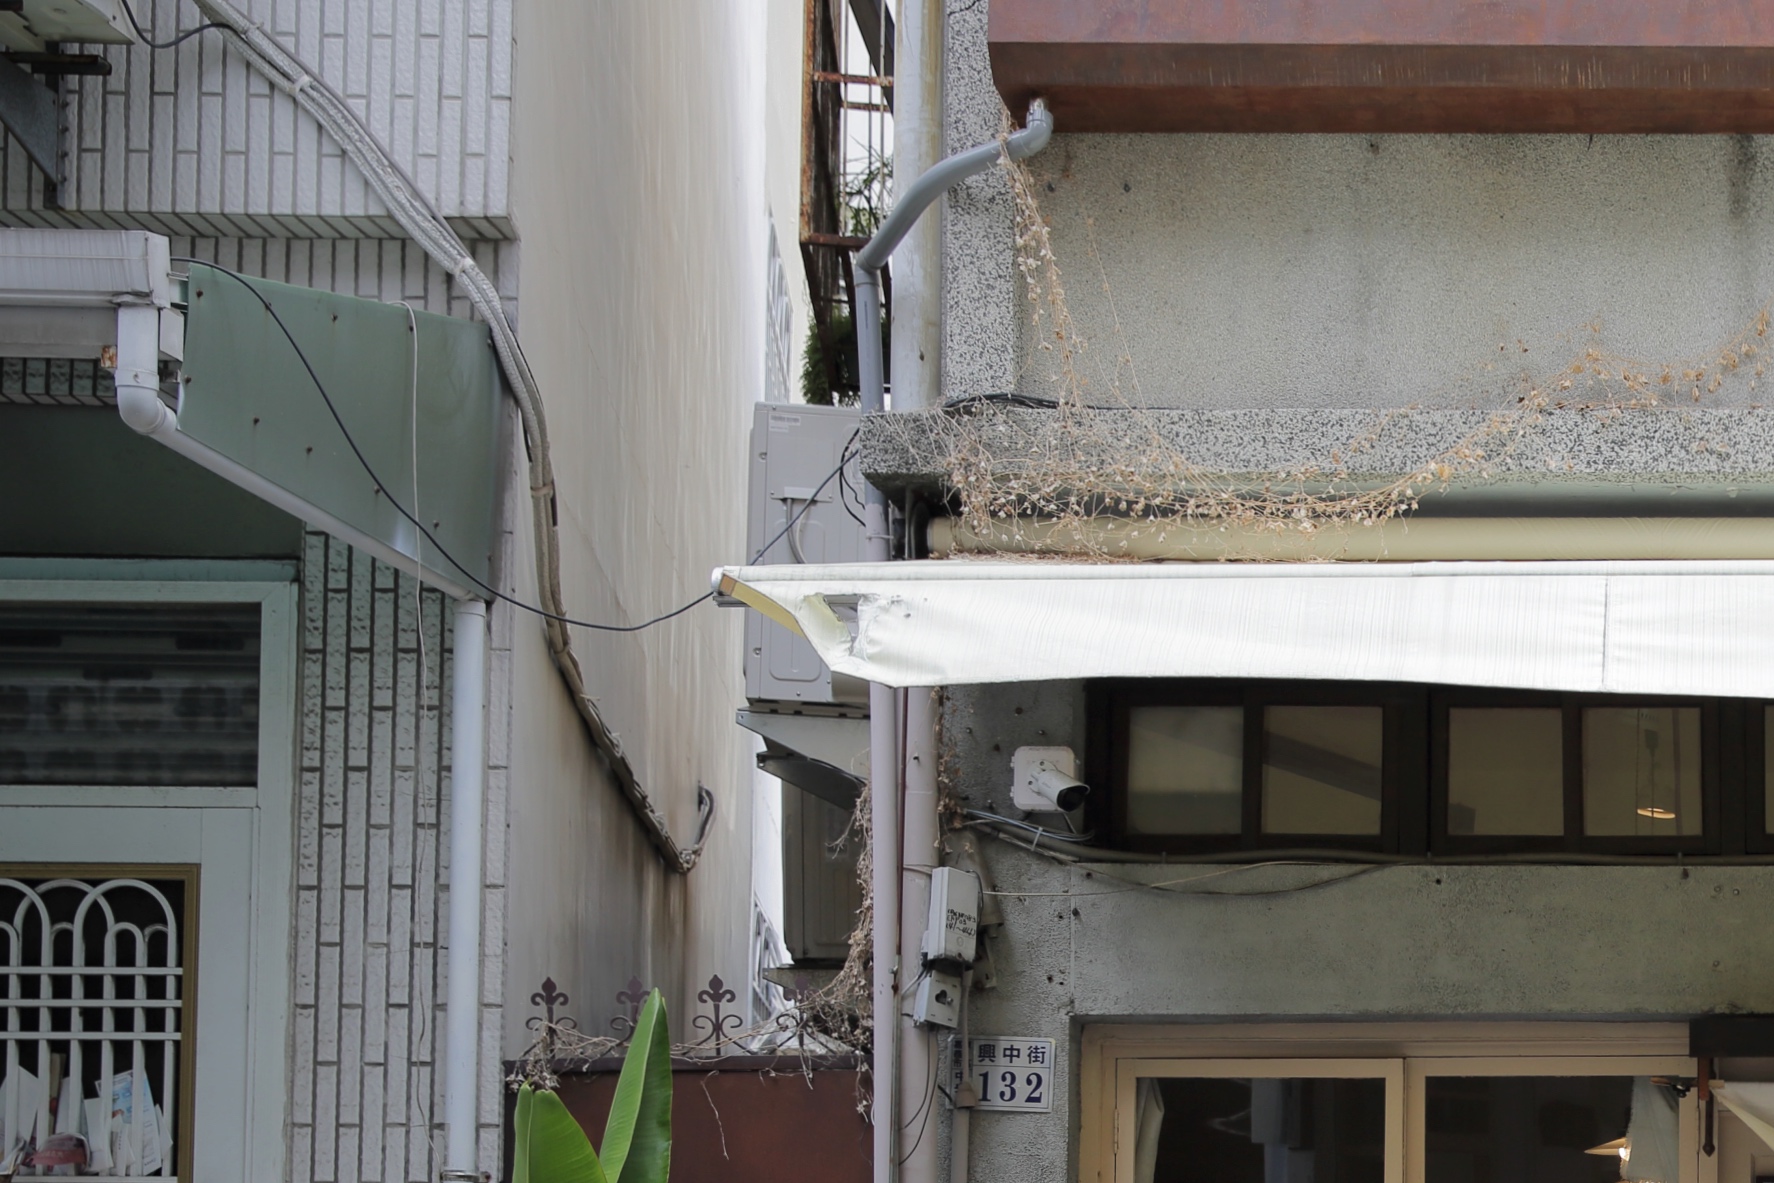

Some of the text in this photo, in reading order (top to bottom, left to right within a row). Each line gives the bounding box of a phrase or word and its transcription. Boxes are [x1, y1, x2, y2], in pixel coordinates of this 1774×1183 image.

[978, 1044, 1046, 1064] 興中街
[978, 1070, 1043, 1103] 132
